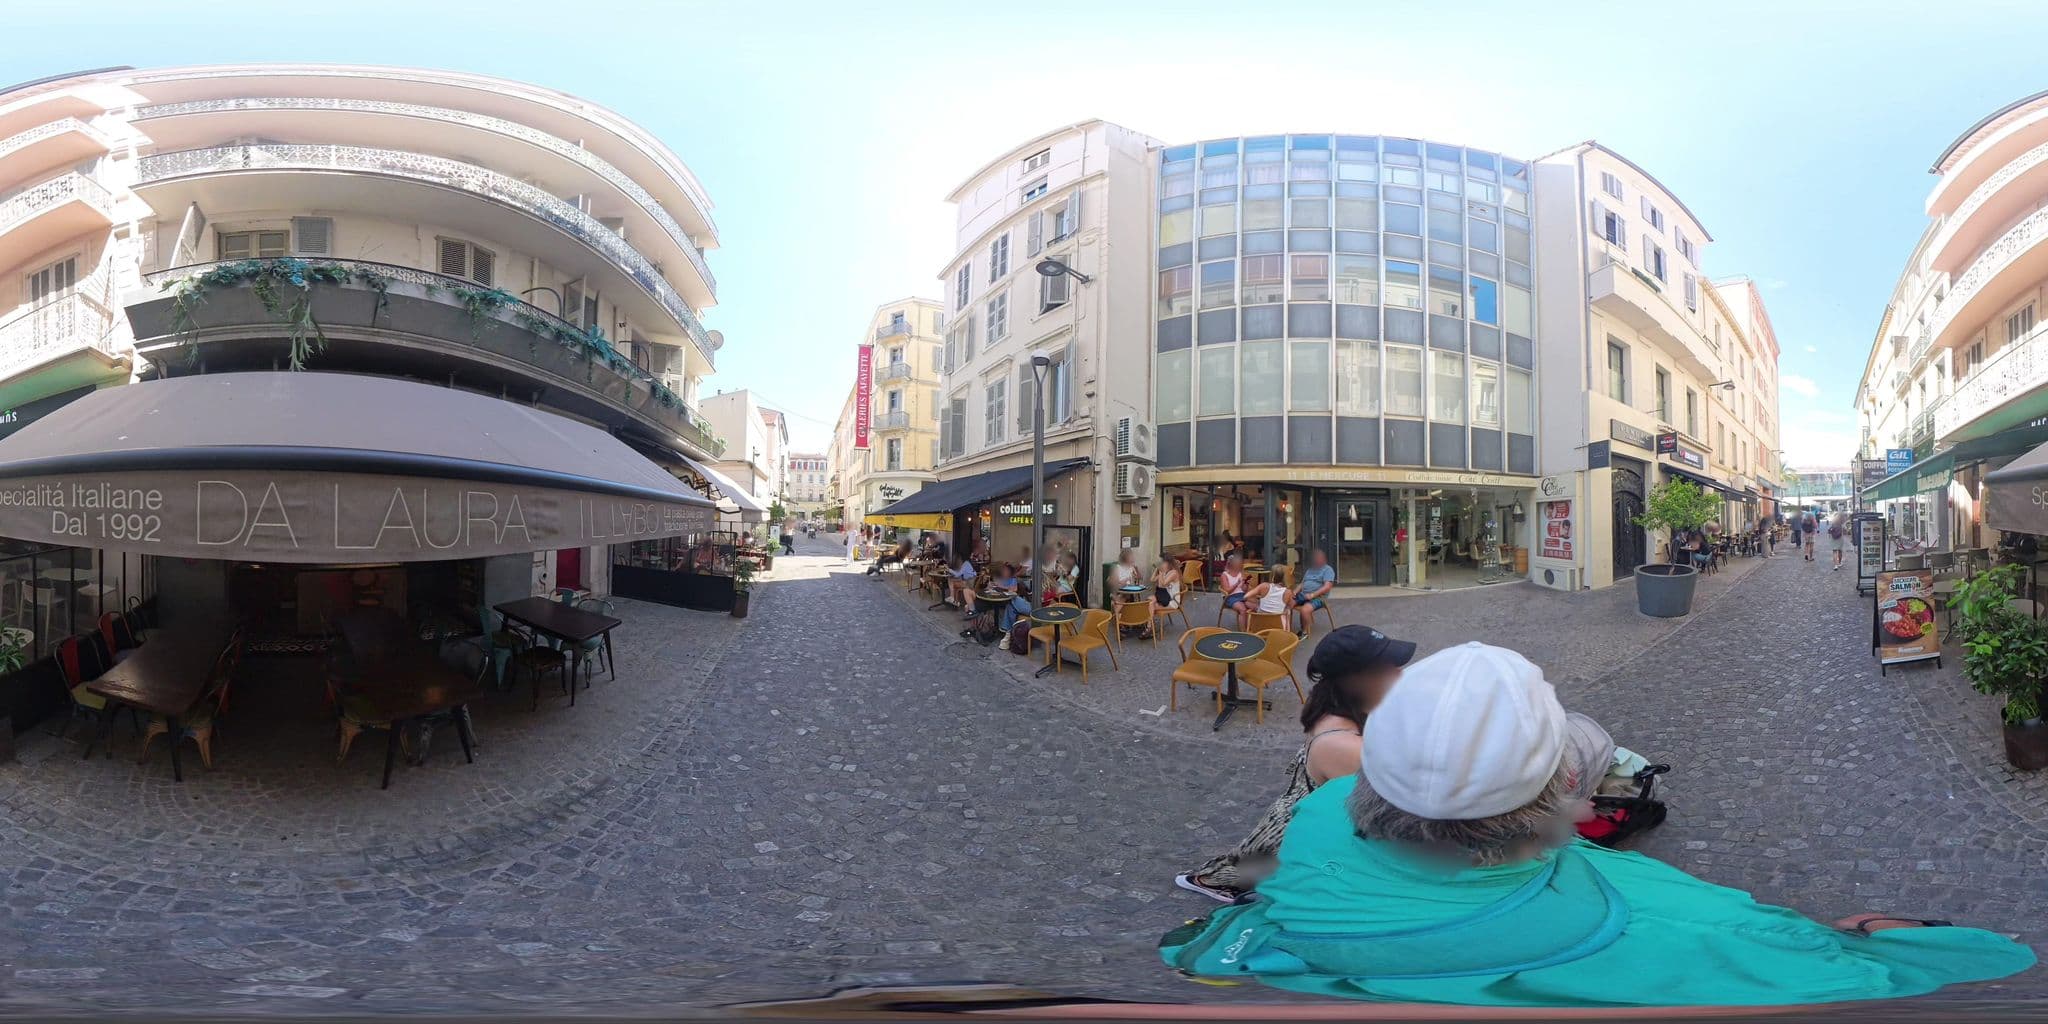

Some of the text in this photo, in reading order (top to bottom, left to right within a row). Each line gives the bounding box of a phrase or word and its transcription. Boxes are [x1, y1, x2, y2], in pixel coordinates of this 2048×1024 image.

[860, 354, 869, 396] LAFAYETTE
[0, 482, 163, 510] ecialitá Italiane
[52, 511, 161, 542] Dal 1992
[196, 480, 531, 549] DA LAURA
